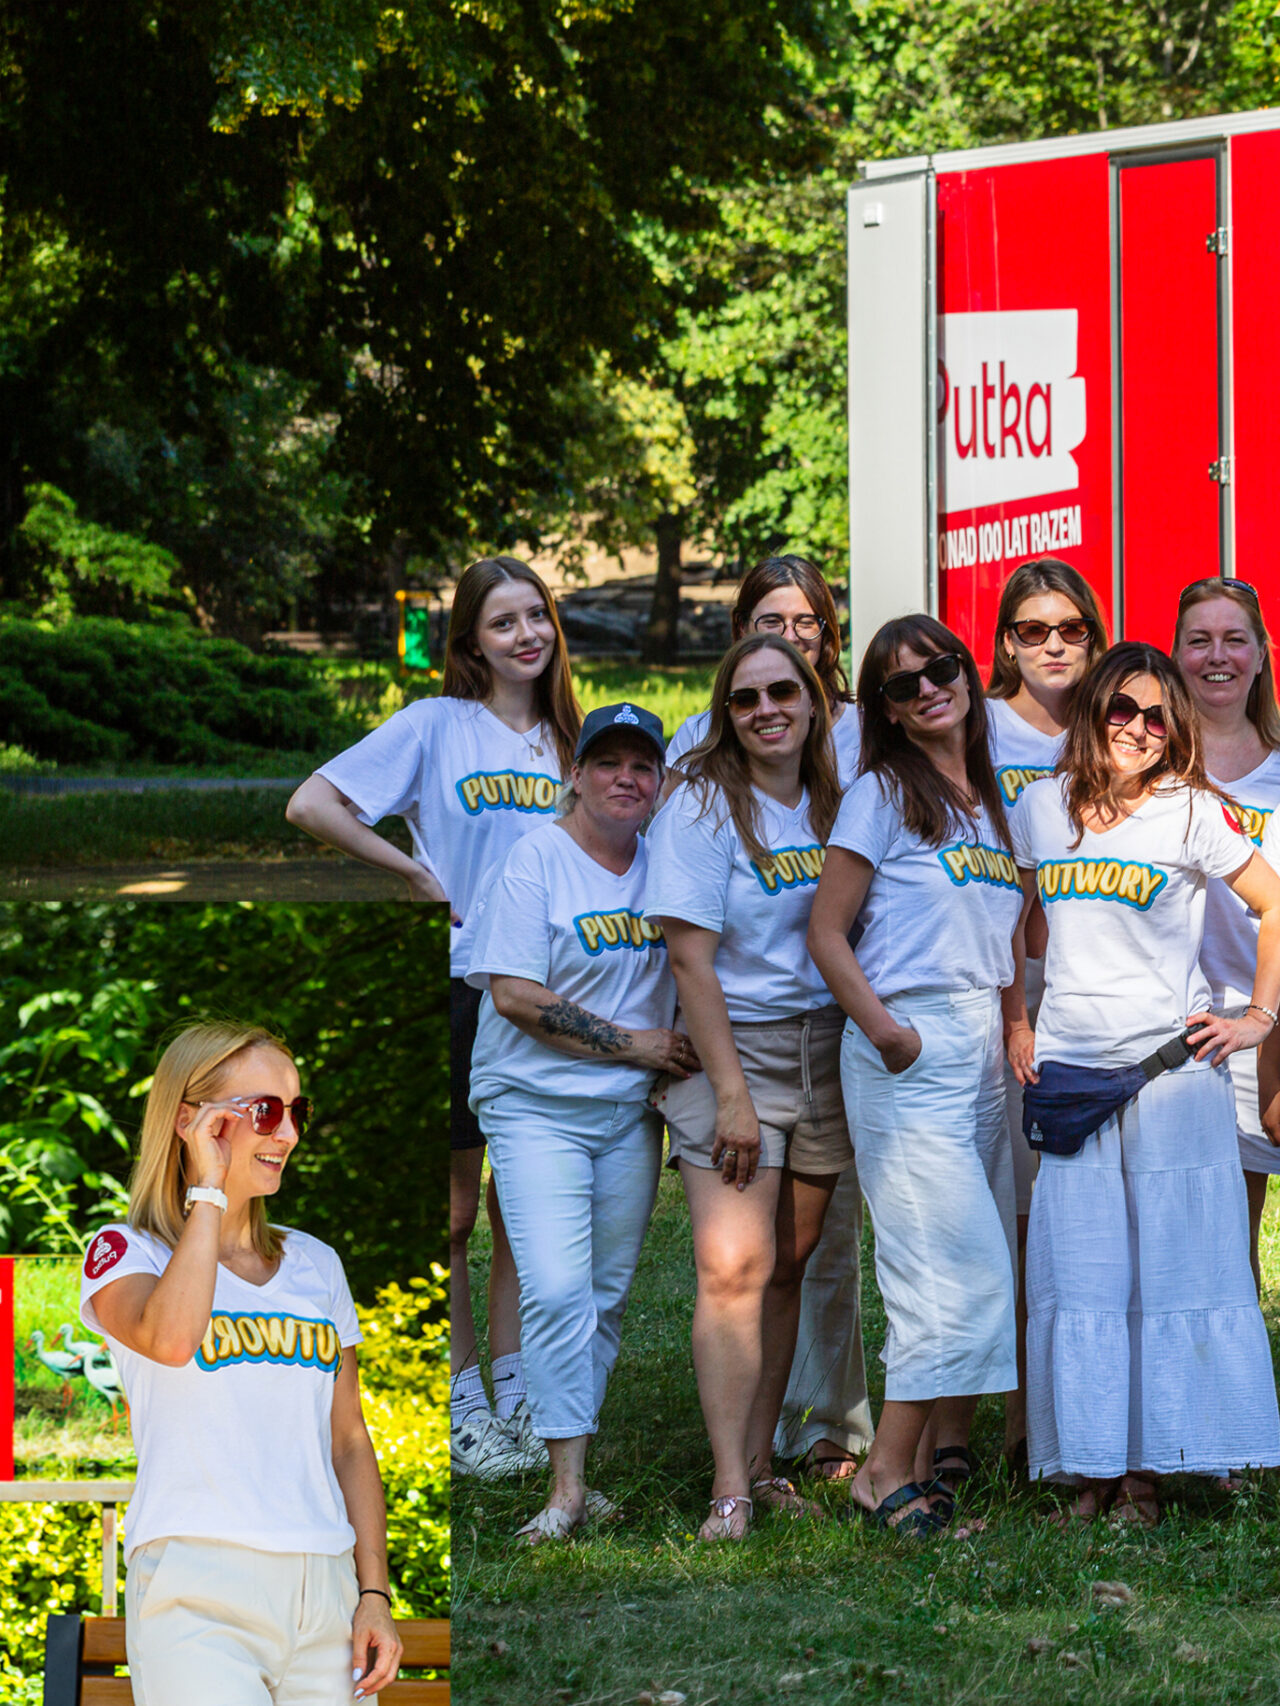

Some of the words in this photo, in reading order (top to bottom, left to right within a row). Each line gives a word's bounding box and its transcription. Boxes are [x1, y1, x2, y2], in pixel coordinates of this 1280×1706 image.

[979, 521, 1001, 563] 100
[1004, 515, 1029, 559] LAT
[1030, 505, 1082, 554] RAZEM
[461, 773, 562, 810] PUTWO
